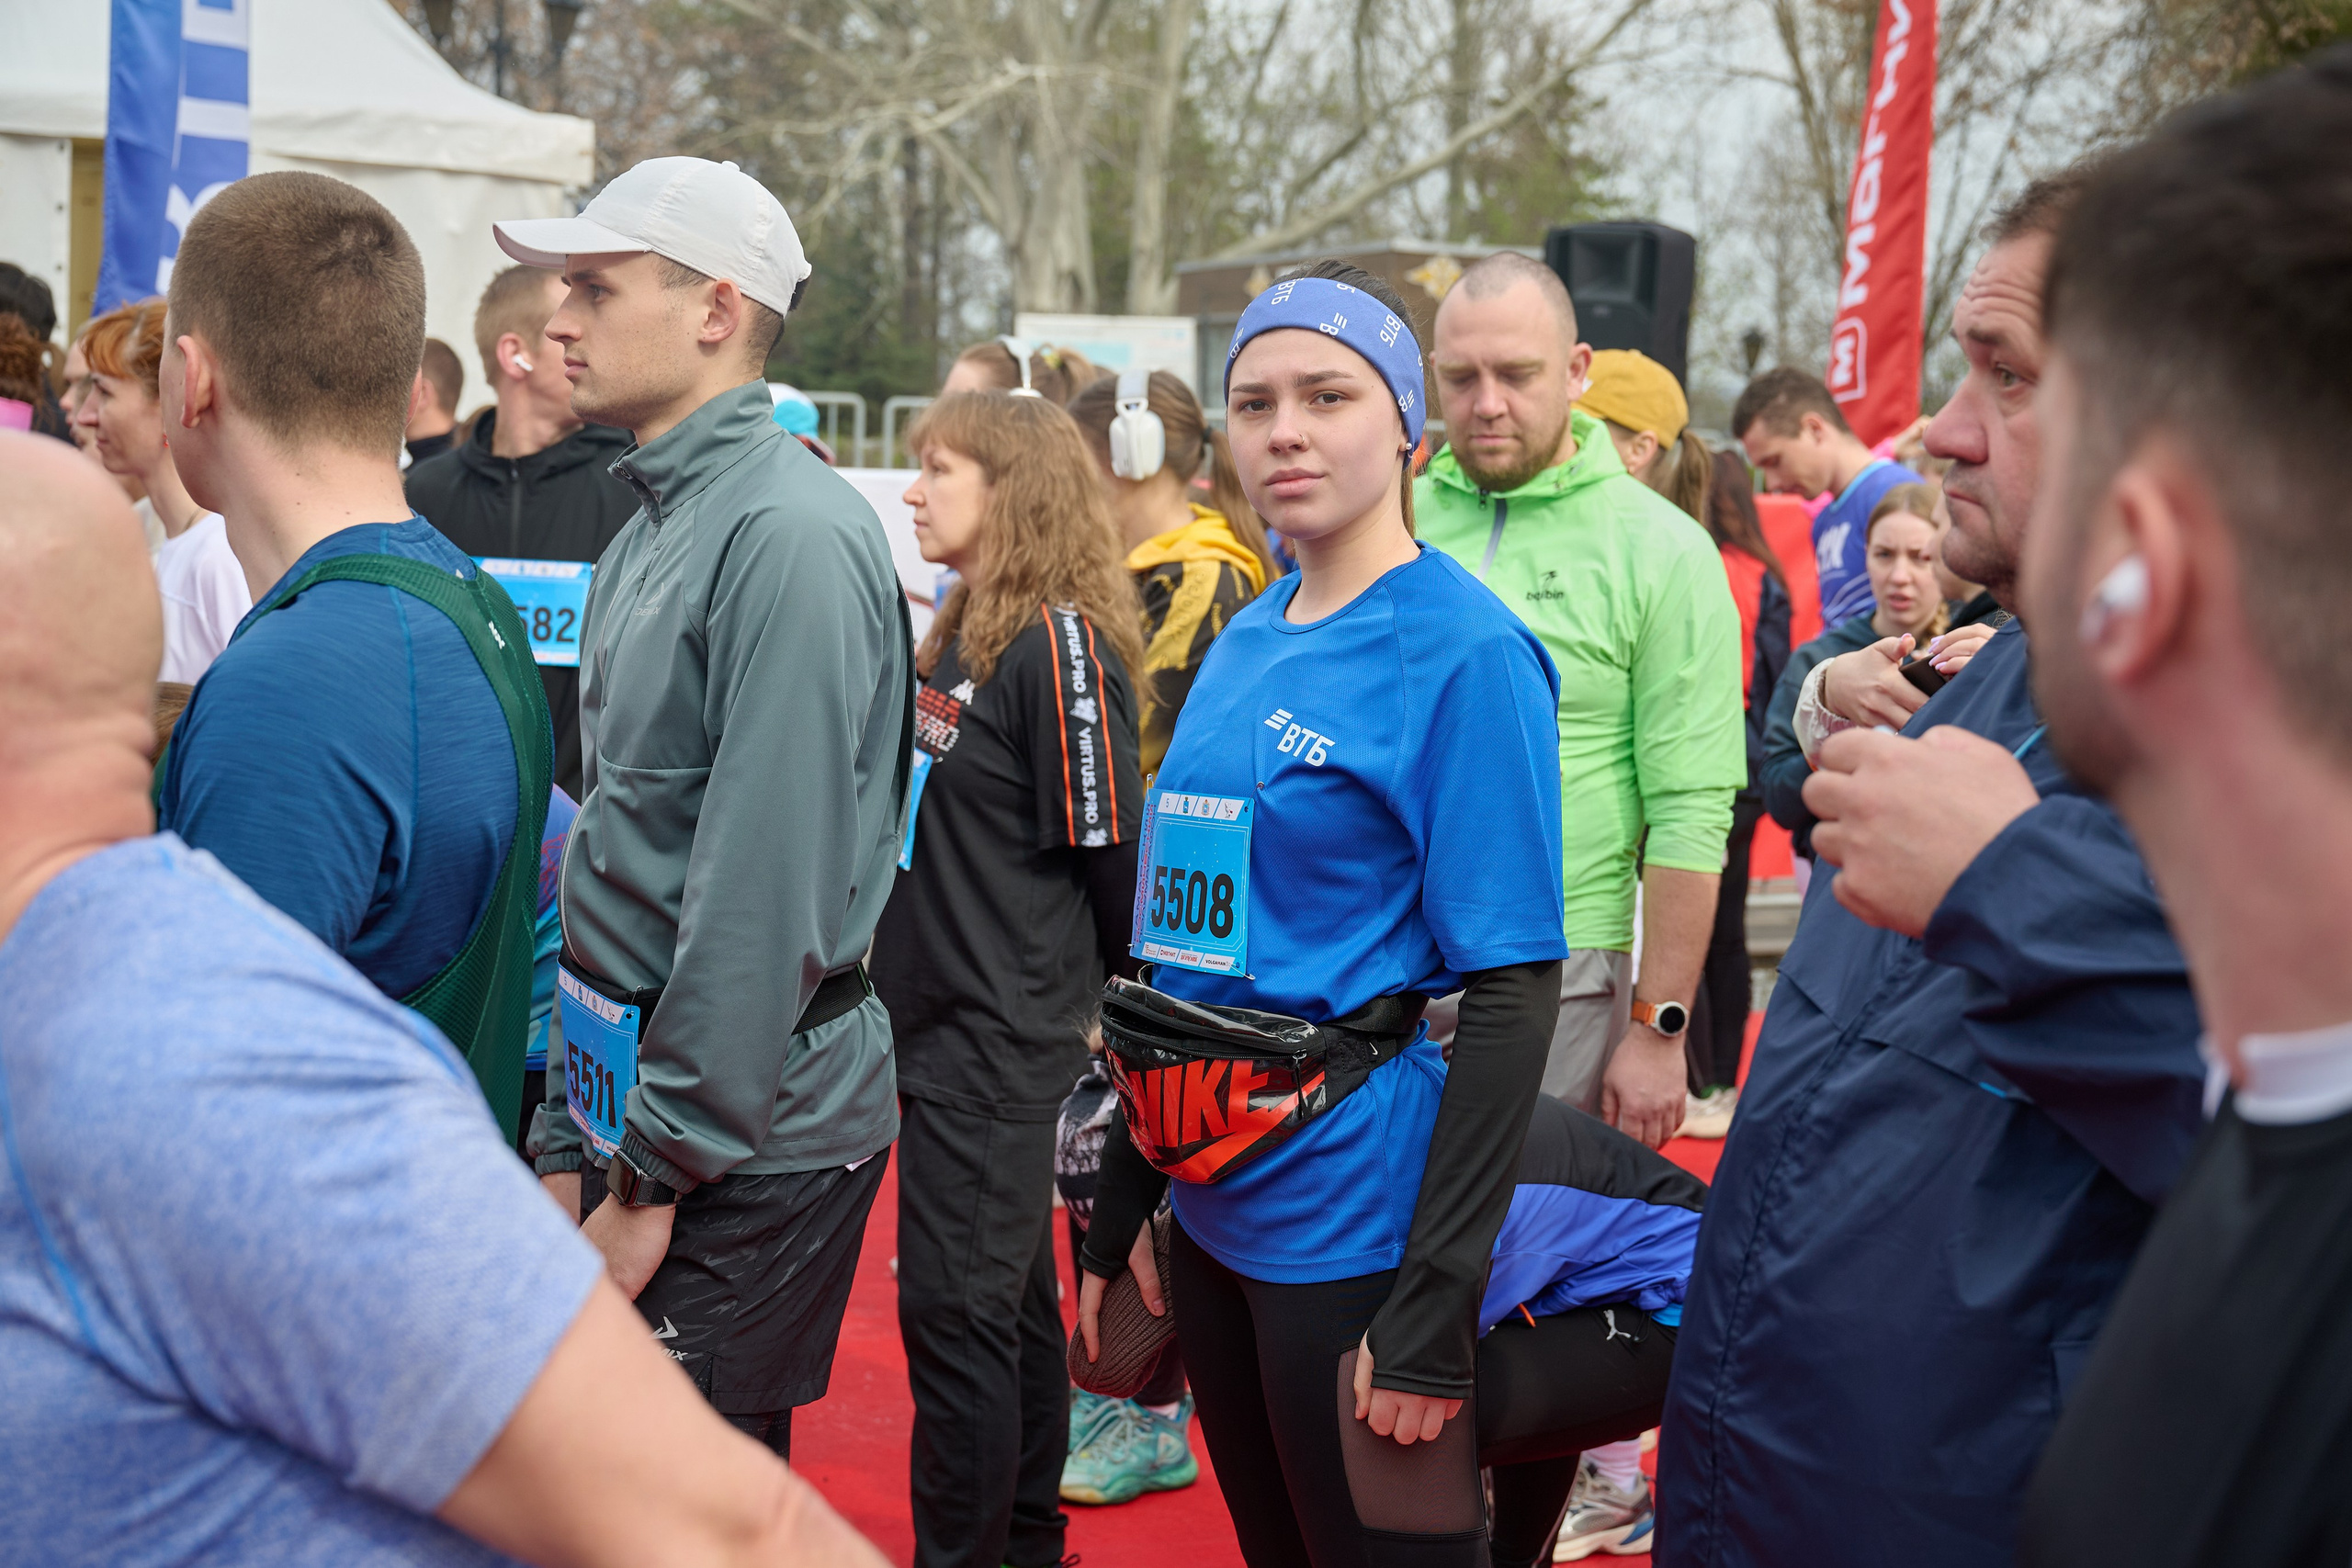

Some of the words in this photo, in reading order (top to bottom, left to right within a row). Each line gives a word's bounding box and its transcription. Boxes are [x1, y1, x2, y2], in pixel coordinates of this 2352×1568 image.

[1272, 280, 1297, 306] ВТБ
[1379, 313, 1404, 348] ВТБ
[1078, 727, 1100, 825] VIRTUS.PRO
[1276, 722, 1336, 767] ВТБ
[1151, 865, 1235, 939] 5508
[567, 1039, 617, 1129] 5511
[1126, 1058, 1270, 1154] NIKE
